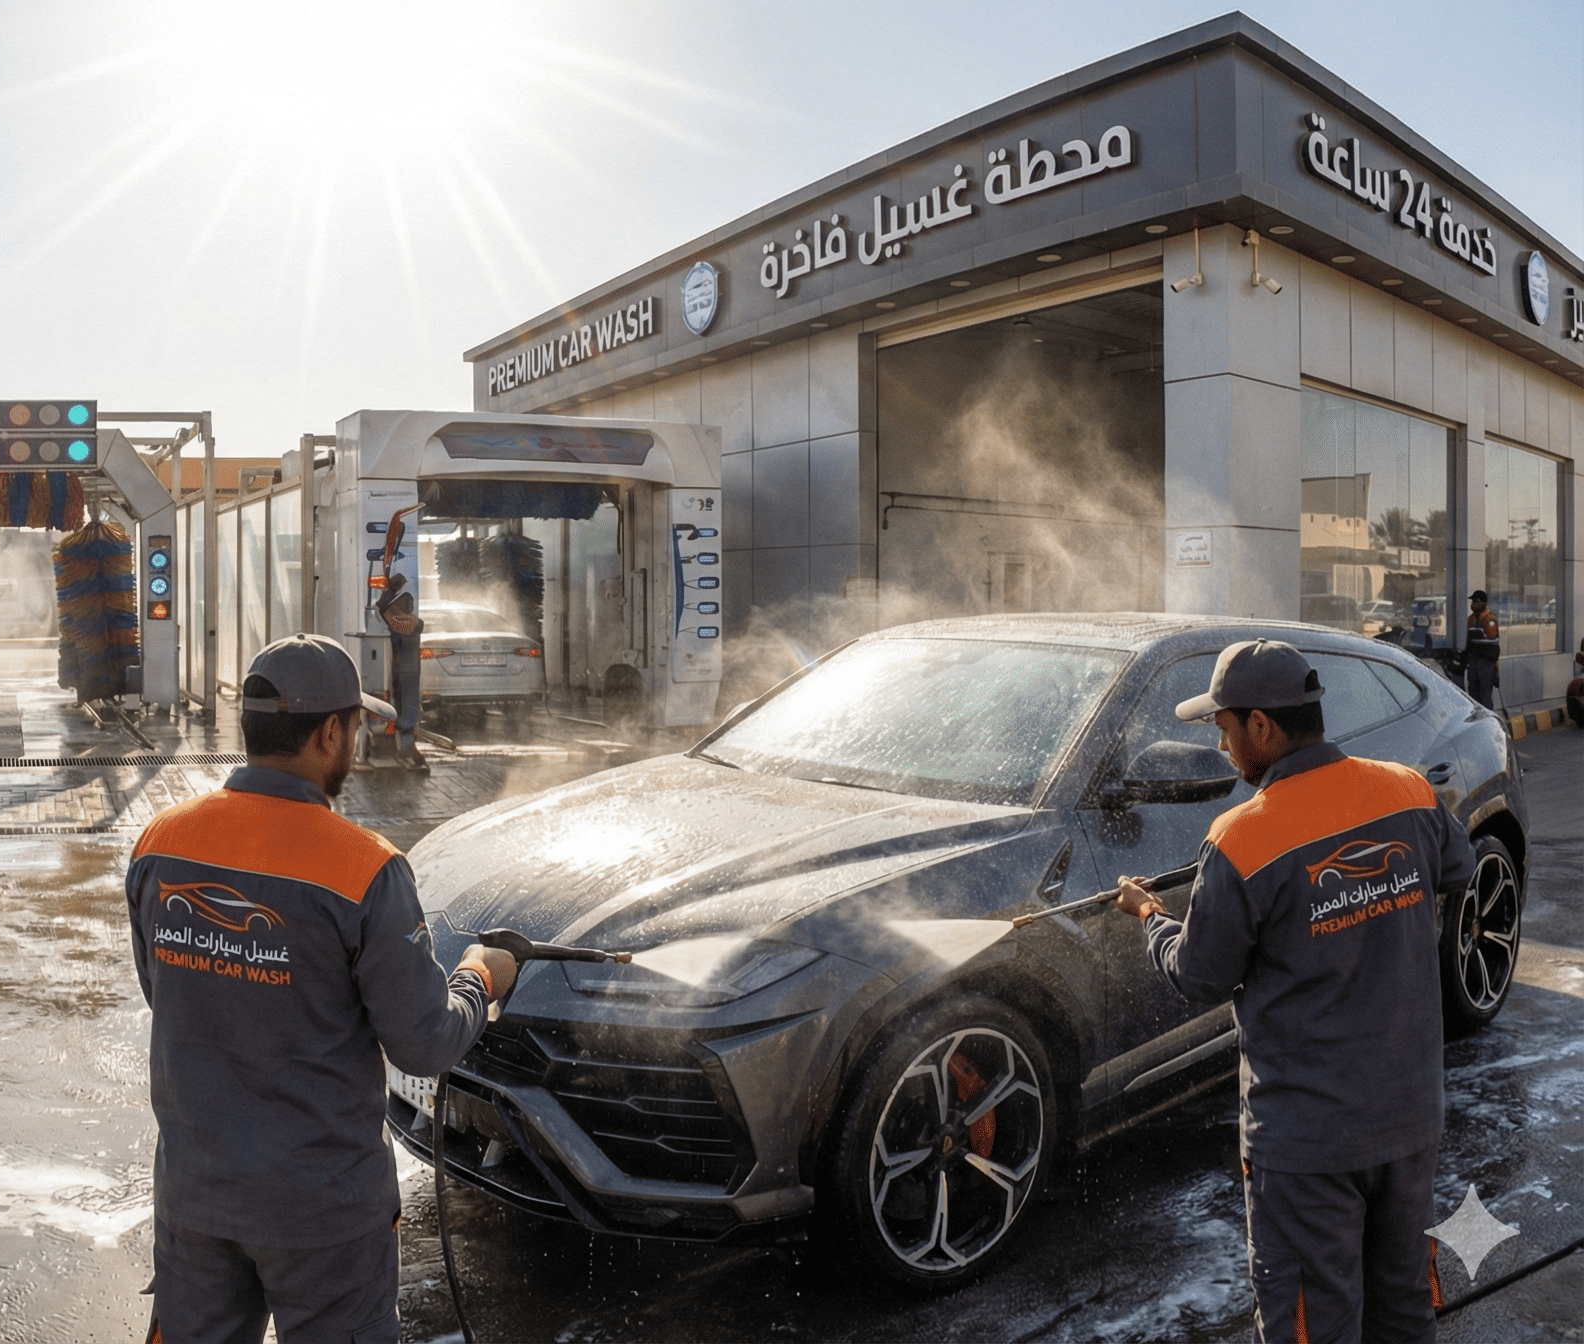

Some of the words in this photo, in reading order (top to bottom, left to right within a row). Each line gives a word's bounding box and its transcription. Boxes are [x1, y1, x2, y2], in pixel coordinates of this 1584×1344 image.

[983, 124, 1133, 205] محطة
[1307, 112, 1390, 213] ساعة
[857, 164, 973, 266] غسيل
[1400, 168, 1433, 239] 24
[759, 213, 848, 299] فاخرة
[1439, 196, 1497, 277] خدمة
[488, 339, 555, 397] PREMIUM
[558, 324, 593, 368] CAR
[595, 296, 654, 353] WASH
[1349, 882, 1388, 905] سيارات
[1390, 868, 1420, 894] غسيل
[1310, 891, 1348, 922] المميز
[1368, 899, 1393, 918] CAR
[154, 923, 192, 946] المميز
[194, 932, 242, 957] سيارات
[245, 940, 290, 964] غسيل
[155, 947, 211, 973] PREMIUM
[215, 959, 243, 979] CAR
[245, 965, 291, 986] WASH
